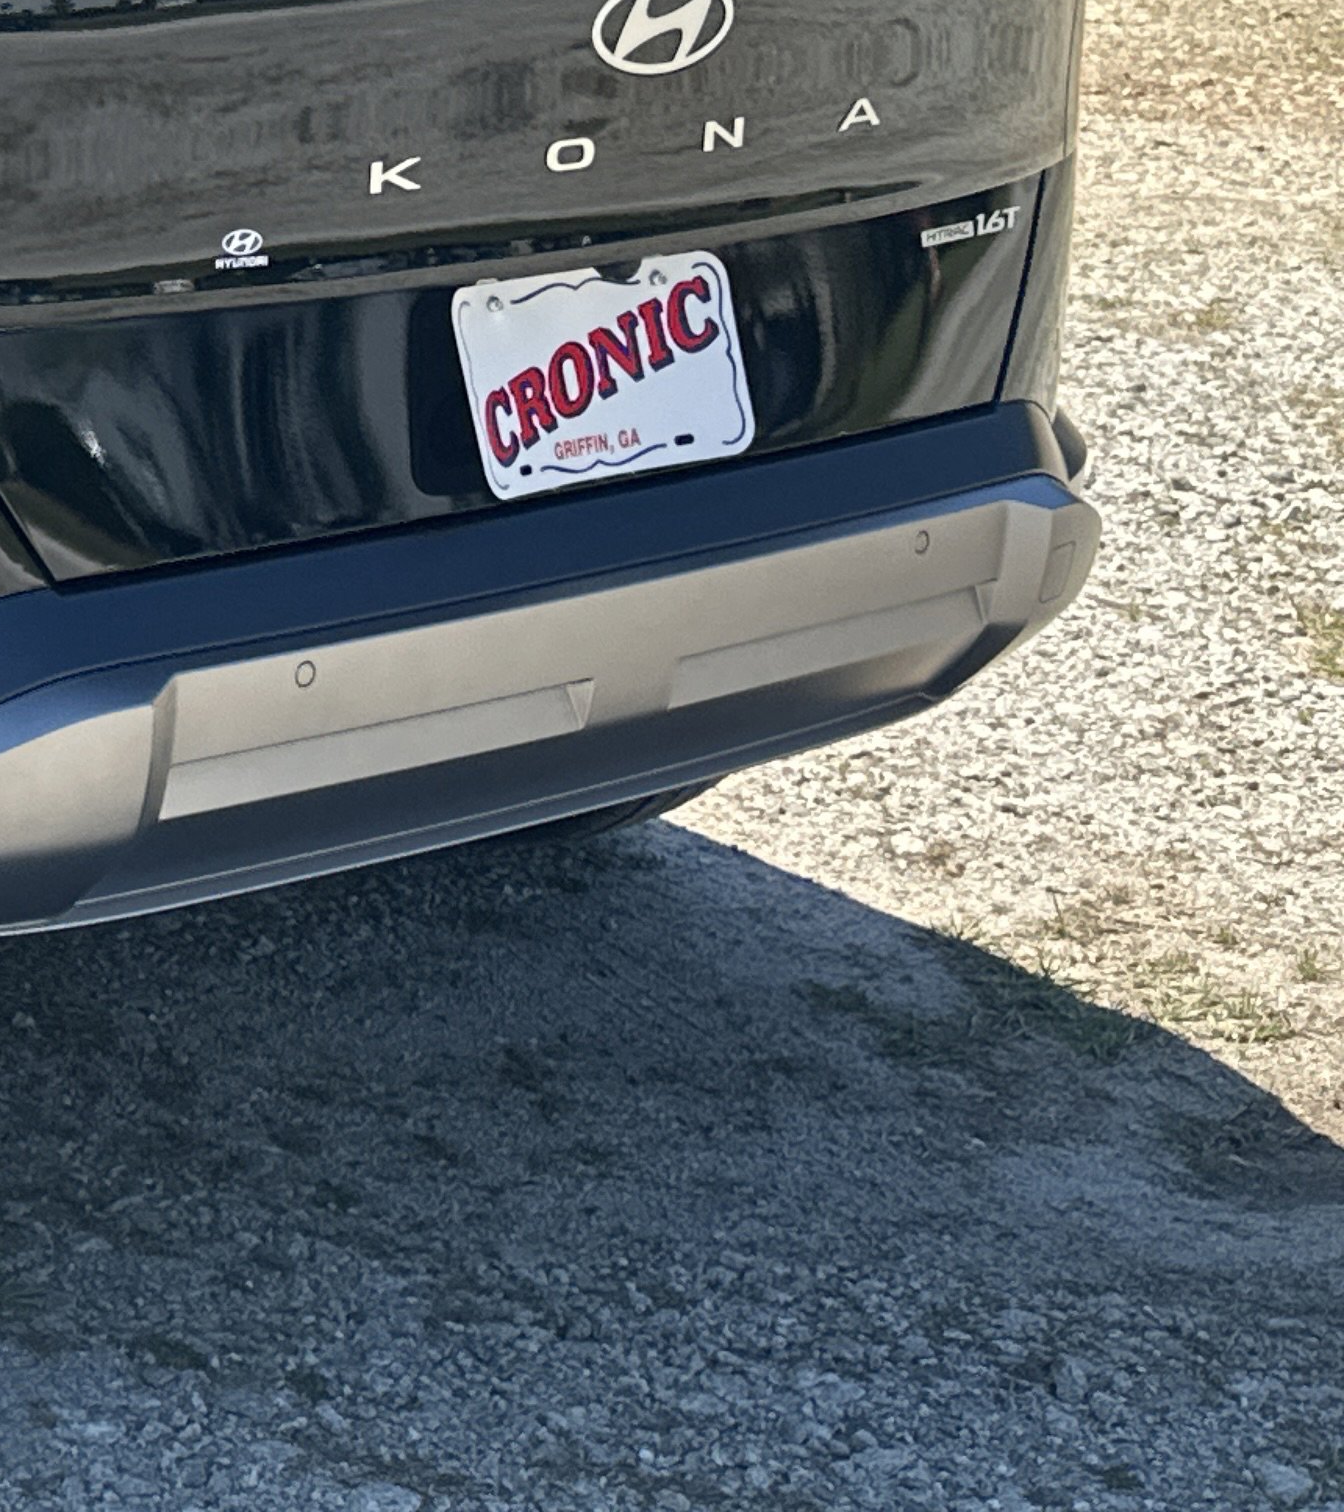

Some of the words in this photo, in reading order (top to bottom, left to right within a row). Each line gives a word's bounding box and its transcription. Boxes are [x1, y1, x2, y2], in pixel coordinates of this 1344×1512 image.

[369, 97, 881, 195] KONA
[485, 275, 719, 468] CRONIC
[554, 433, 615, 460] GRIFFIN,
[618, 428, 642, 449] GA
